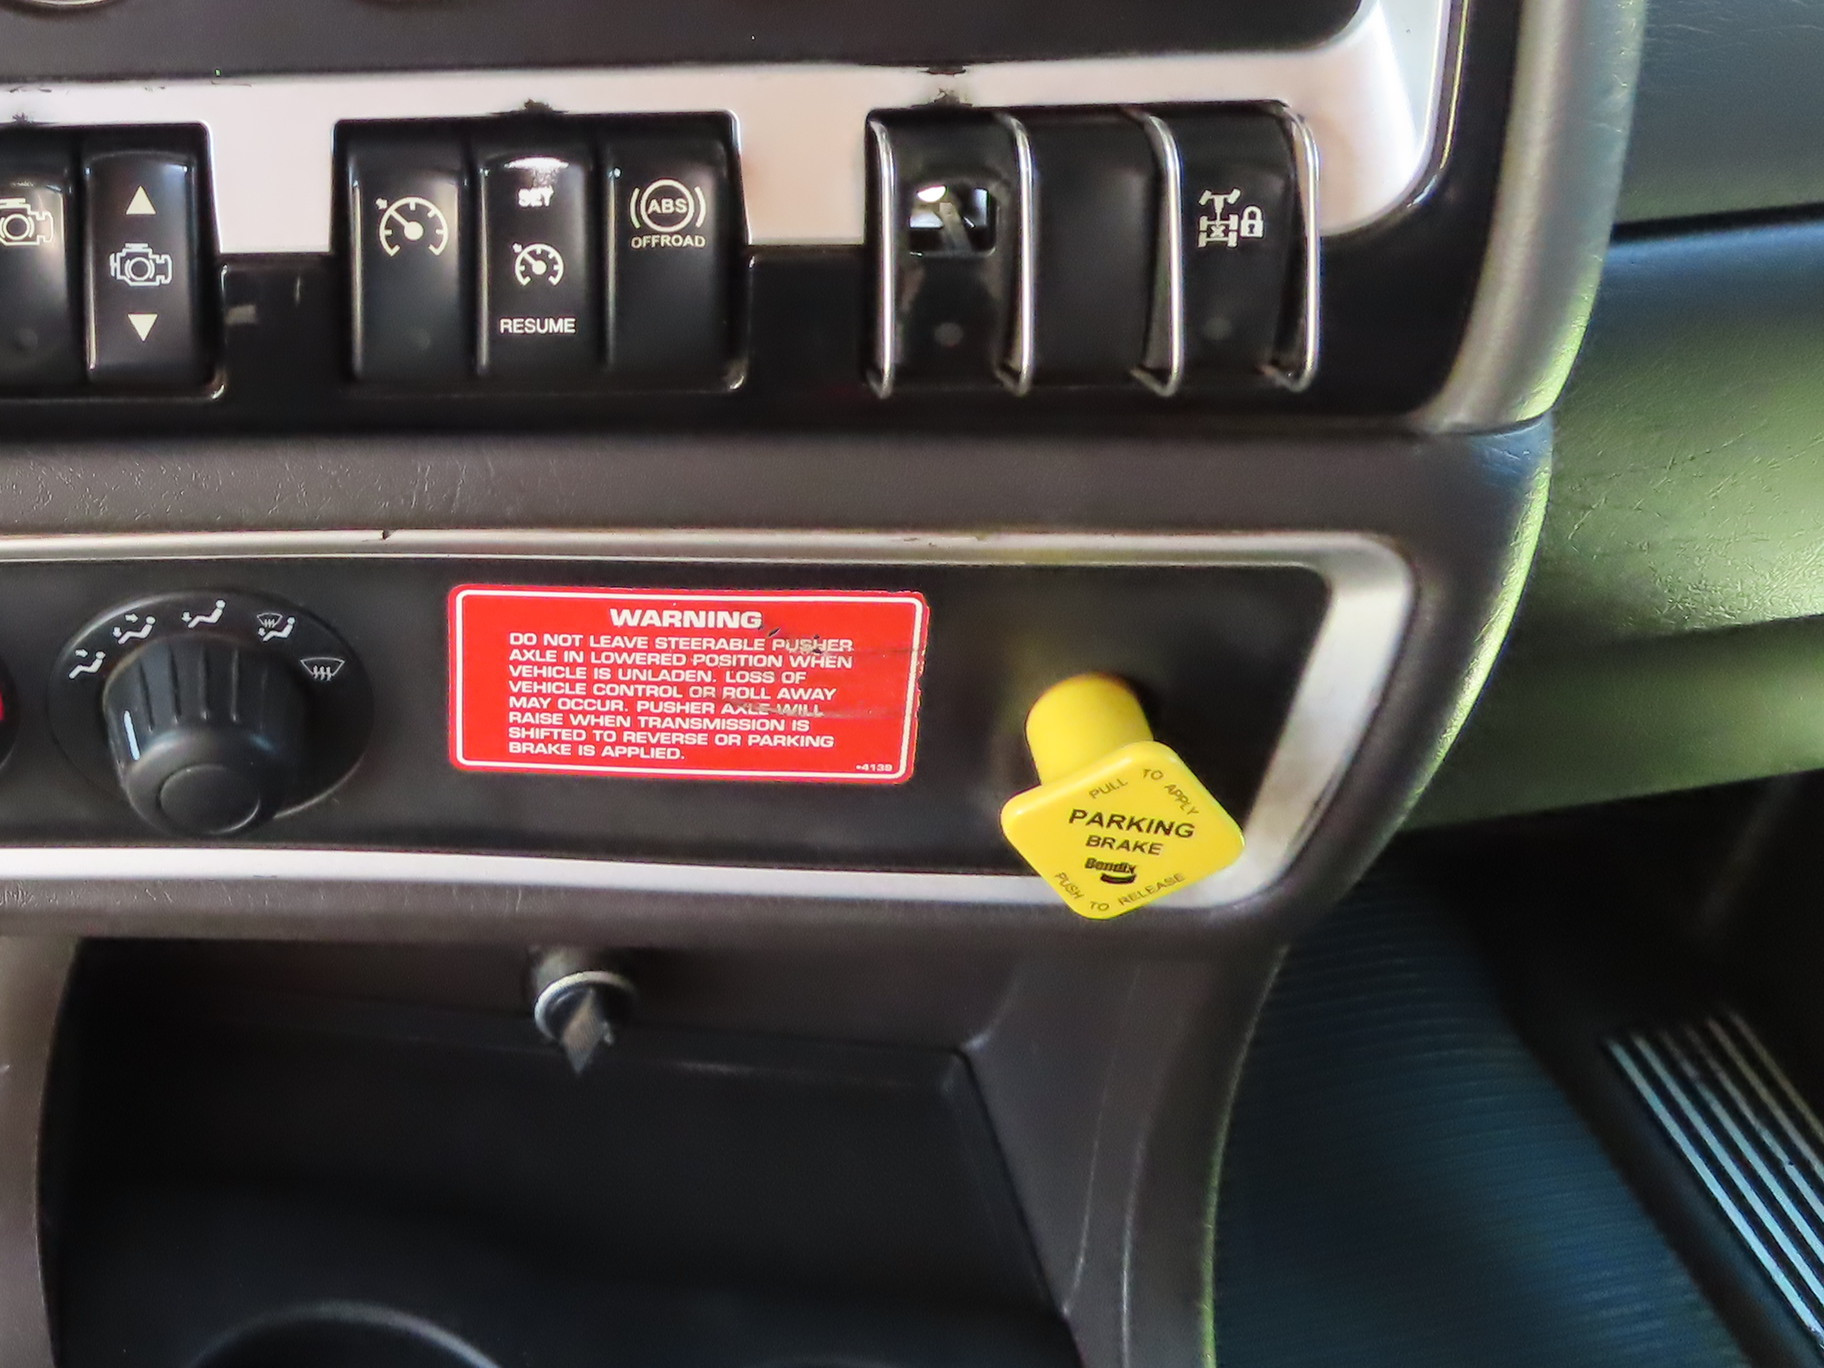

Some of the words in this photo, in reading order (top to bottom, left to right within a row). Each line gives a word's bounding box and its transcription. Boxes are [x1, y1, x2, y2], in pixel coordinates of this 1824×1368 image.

[518, 187, 554, 207] SET
[647, 199, 688, 214] ABS
[631, 235, 706, 249] OFFROAD
[500, 318, 576, 335] RESUME
[610, 608, 763, 629] WARNING
[509, 632, 537, 646] DO
[543, 634, 584, 647] NOT
[589, 635, 649, 649] LEAVE
[655, 636, 766, 651] STEERABLE
[772, 638, 854, 652] PUSHER
[509, 649, 557, 662] AXLE
[564, 650, 584, 663] IN
[591, 651, 686, 666] LOWERED
[693, 653, 783, 668] POSITION
[789, 655, 853, 669] WHEN
[508, 664, 587, 679] VEHICLE
[593, 667, 612, 680] IS
[618, 668, 717, 683] UNLADEN.
[726, 671, 775, 684] LOSS
[781, 671, 807, 684] OF
[508, 680, 587, 695] VEHICLE
[592, 683, 683, 698] CONTROL
[688, 686, 716, 698] OR
[722, 687, 771, 700] ROLL
[776, 688, 837, 701] AWAY
[508, 696, 552, 709] MAY
[557, 697, 628, 712] OCCUR.
[637, 700, 715, 714] PUSHER
[720, 702, 770, 715] AXLE
[776, 703, 824, 716] WILL
[508, 712, 564, 725] RAISE
[569, 714, 631, 727] WHEN
[637, 715, 785, 731] TRANSMISSION
[792, 719, 810, 731] IS
[508, 727, 587, 741] SHIFTED
[592, 729, 617, 742] TO
[623, 730, 708, 745] REVERSE
[714, 734, 742, 746] OR
[747, 734, 835, 748] PARKING
[508, 742, 572, 756] BRAKE
[578, 744, 596, 756] IS
[601, 745, 685, 760] APPLIED.
[1088, 778, 1128, 800] PULL
[1142, 768, 1164, 781] TO
[1164, 783, 1200, 817] APPLY
[1069, 808, 1196, 839] PARKING
[1085, 834, 1164, 856] BRAKE
[1085, 857, 1137, 875] Bendix
[1054, 871, 1085, 899] PUSH
[1089, 901, 1110, 912] TO
[1118, 873, 1185, 907] RELEASE
